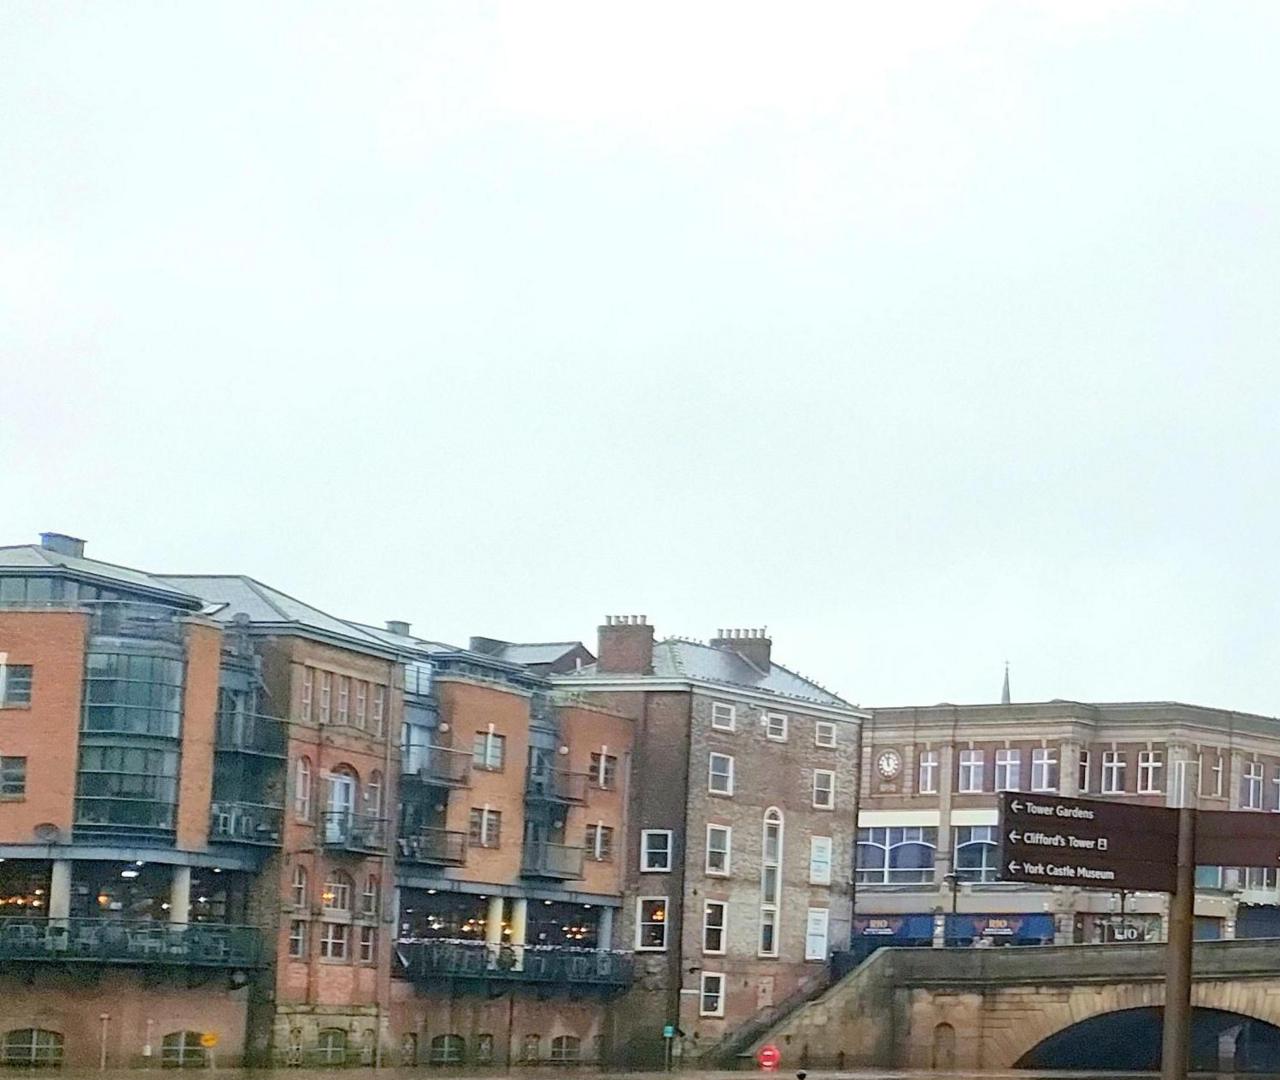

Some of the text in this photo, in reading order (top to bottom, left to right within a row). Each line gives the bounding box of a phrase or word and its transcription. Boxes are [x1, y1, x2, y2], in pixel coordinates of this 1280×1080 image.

[1025, 802, 1094, 819] Tower Gardens
[1023, 832, 1096, 849] Clifford's Tower
[1022, 862, 1115, 880] York Castle Museum
